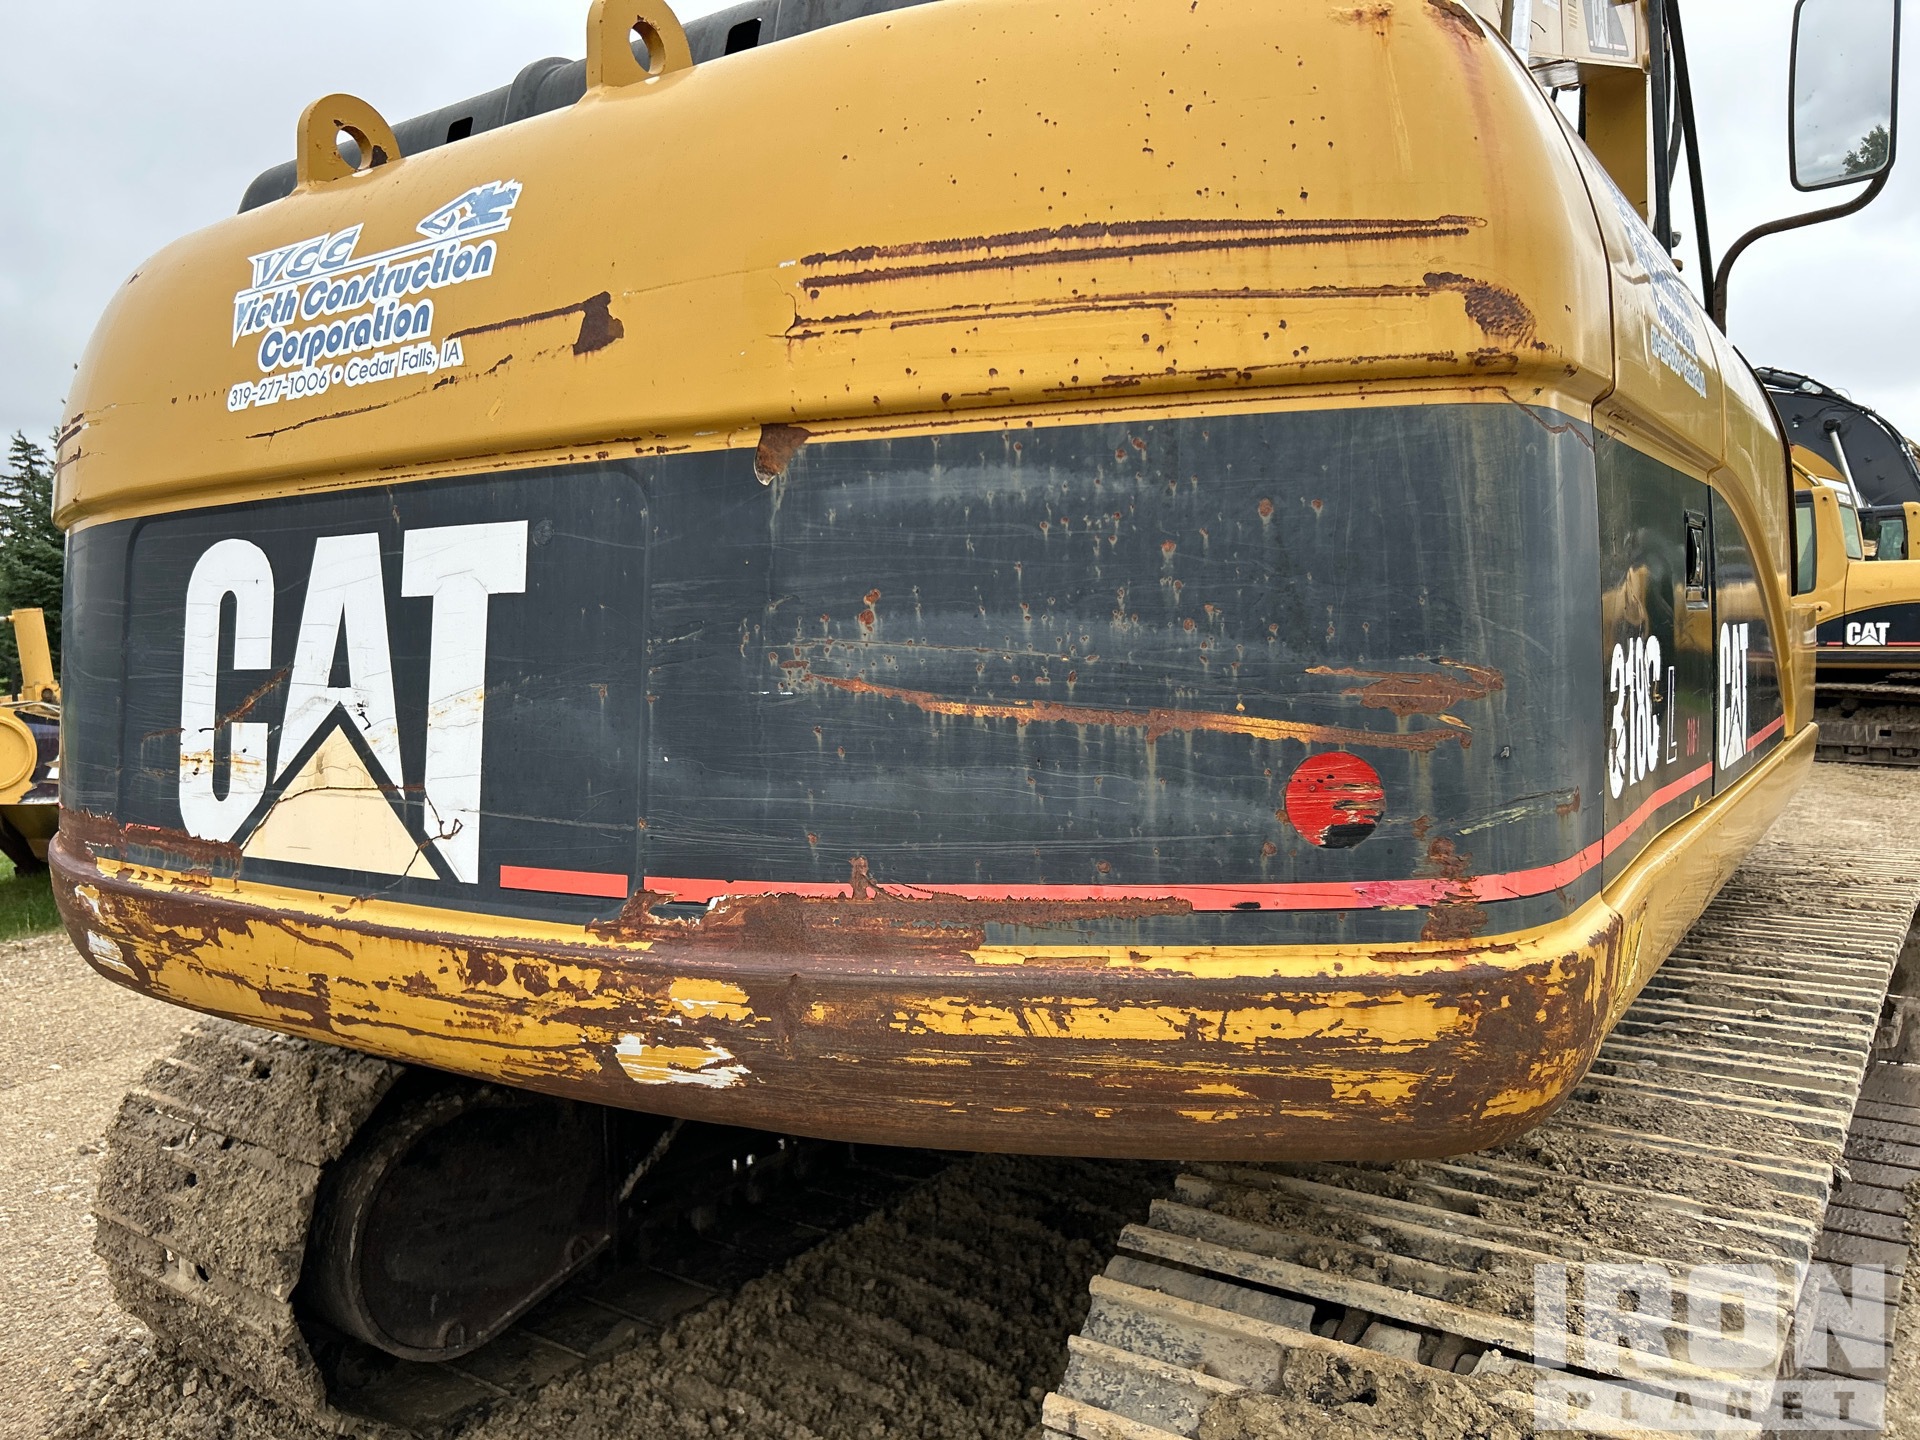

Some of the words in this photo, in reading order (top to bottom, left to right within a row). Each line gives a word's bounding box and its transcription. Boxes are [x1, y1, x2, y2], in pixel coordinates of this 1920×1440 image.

[236, 289, 297, 338] Vieth
[303, 241, 494, 316] Construction
[254, 227, 361, 288] VCC
[261, 302, 431, 367] Corporation
[230, 373, 328, 407] 319-277-1006
[347, 354, 396, 382] Cedar
[401, 346, 436, 372] Falls,
[443, 341, 460, 362] IA
[1846, 621, 1891, 646] CAT
[179, 520, 529, 884] CAT
[1719, 622, 1749, 771] CAT
